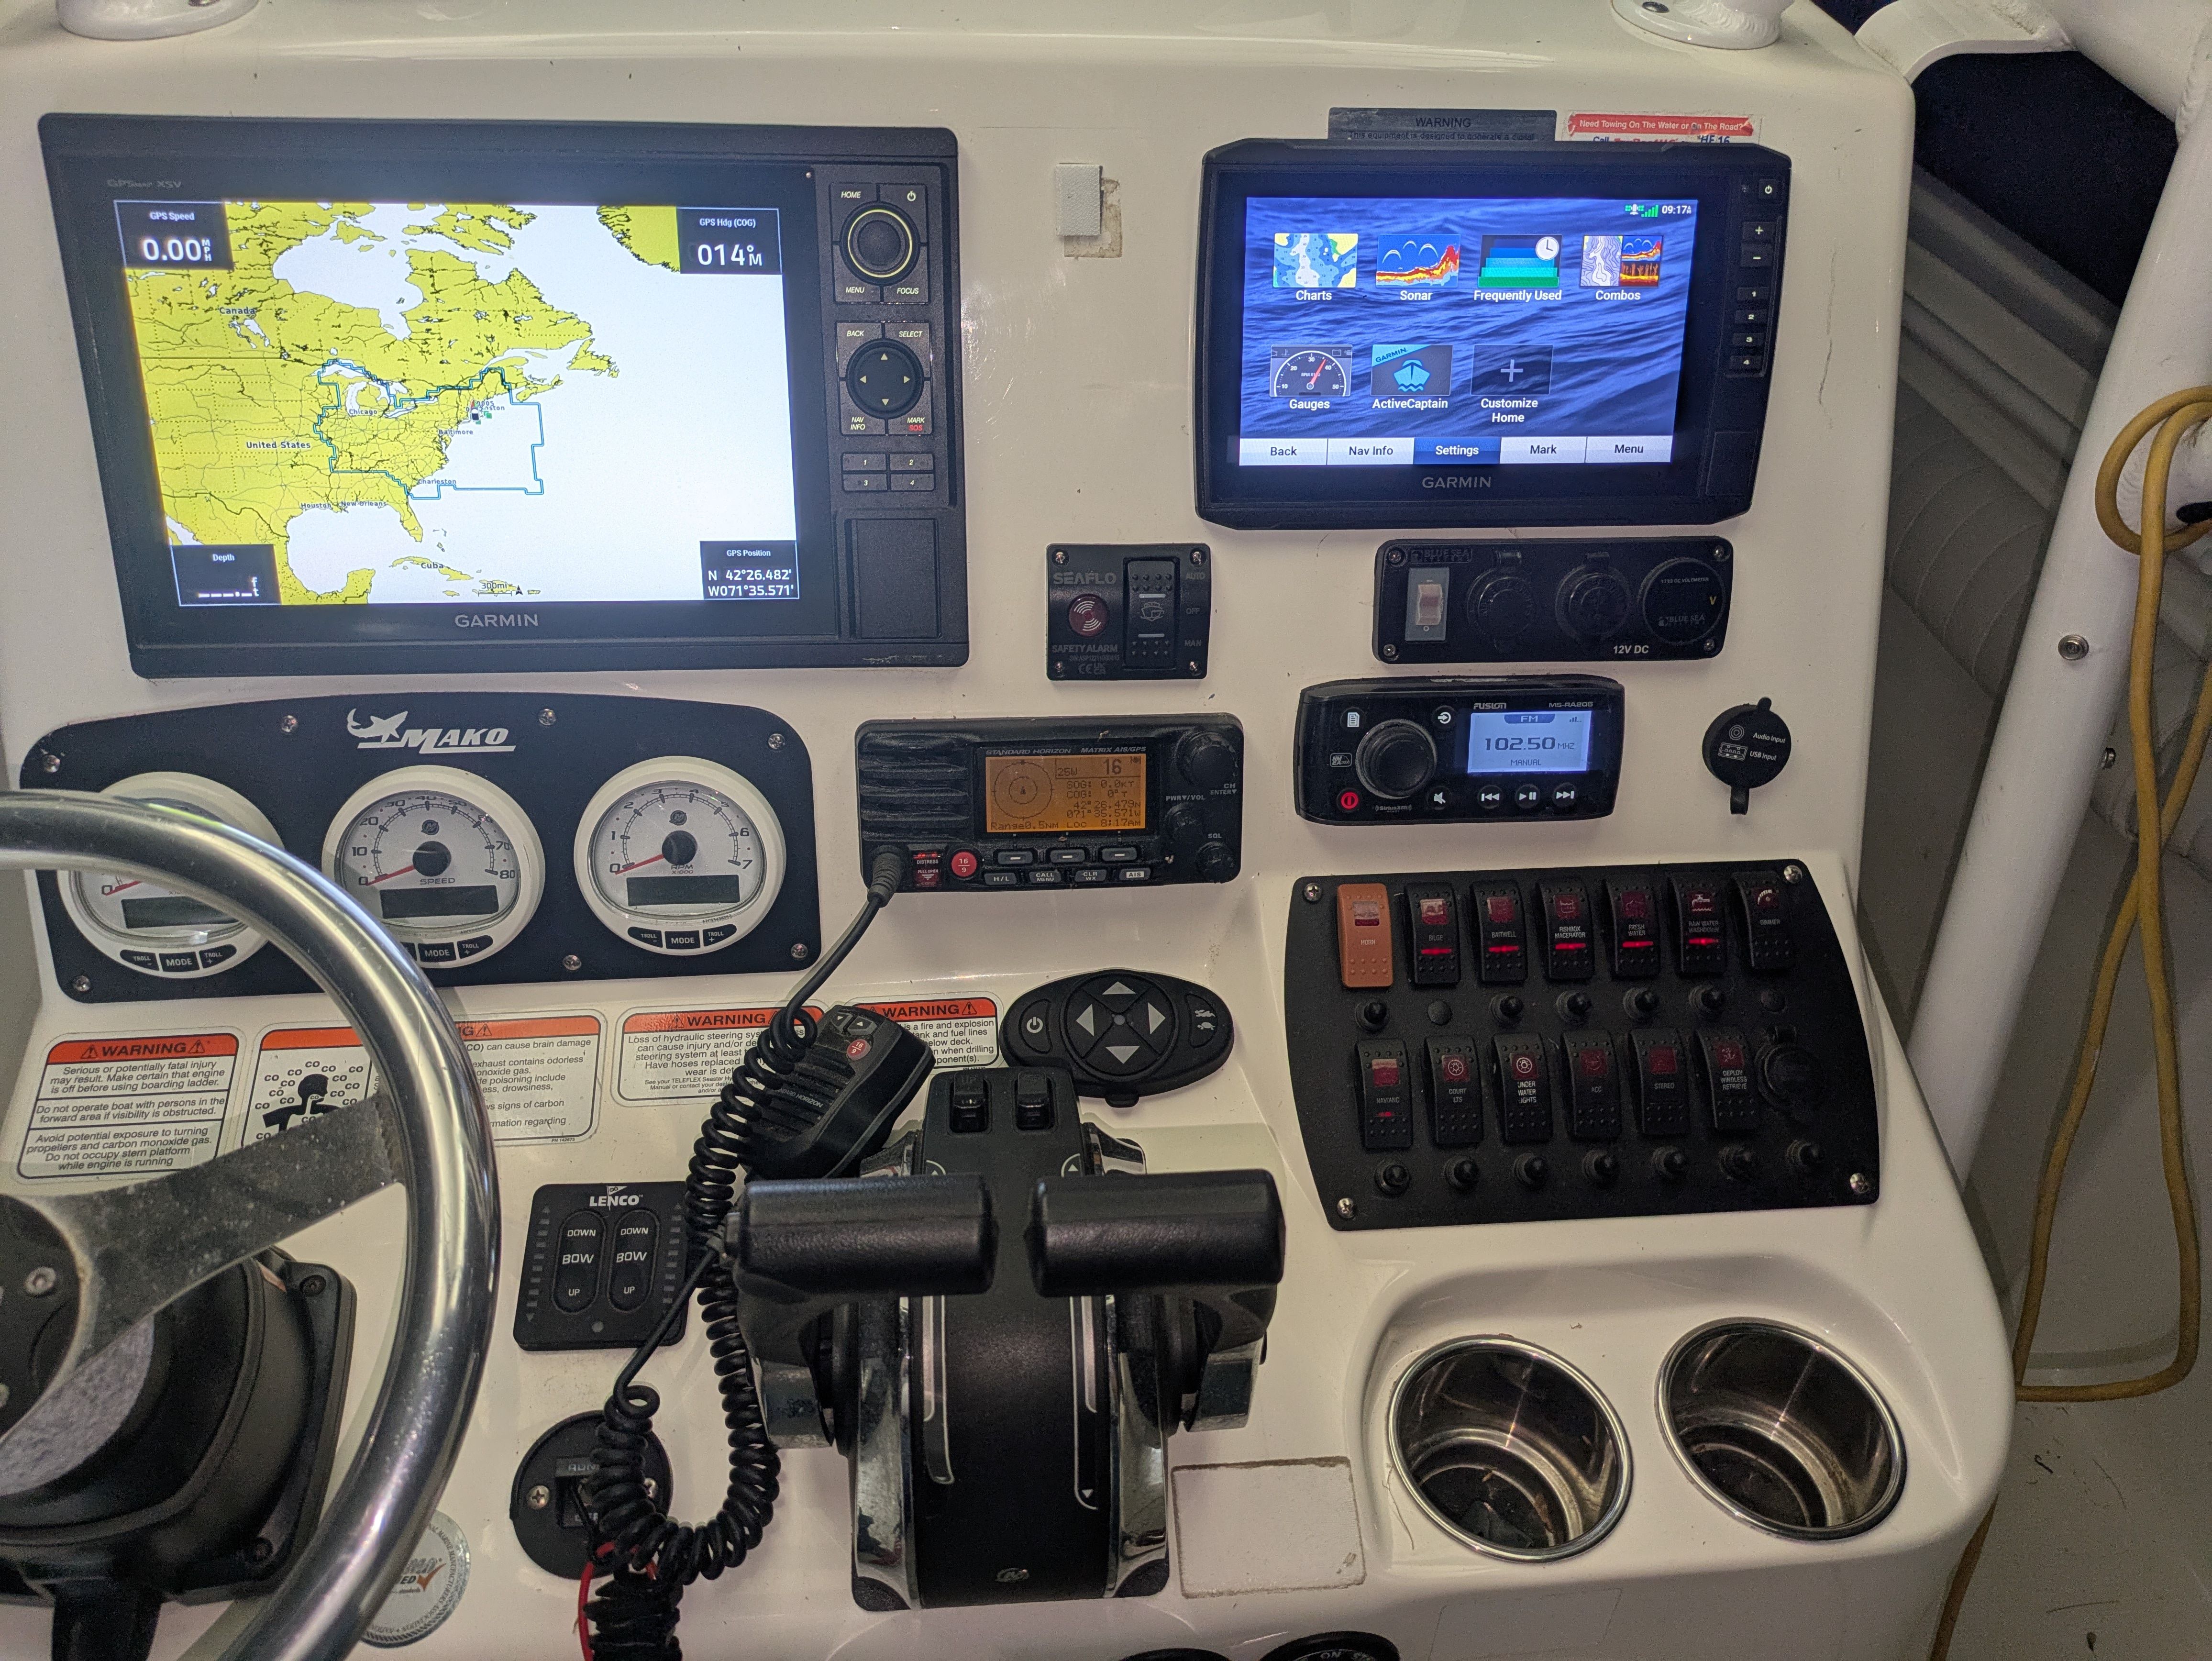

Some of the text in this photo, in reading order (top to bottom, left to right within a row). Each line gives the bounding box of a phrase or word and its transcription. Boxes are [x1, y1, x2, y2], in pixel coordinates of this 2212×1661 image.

[1416, 117, 1471, 127] WARNING
[1601, 121, 1626, 130] Towing
[150, 211, 195, 221] GPS Speed
[718, 219, 732, 228] Hdg
[734, 219, 756, 228] (COG)
[144, 239, 201, 261] 0.00
[1296, 290, 1332, 300] Charts
[1400, 290, 1433, 300] Sonar
[1474, 290, 1561, 302] Frequently Used
[1595, 290, 1640, 300] Combos
[219, 307, 256, 315] Canada
[1375, 347, 1408, 363] GARMIN
[1289, 399, 1330, 410] Gauges
[1372, 399, 1448, 410] ActiveCaptain
[1481, 398, 1538, 409] Customize
[1492, 413, 1524, 422] Home
[246, 441, 311, 449] United States
[1349, 446, 1393, 455] Nav Info
[1530, 445, 1557, 454] Mark
[1615, 444, 1644, 454] Menu
[1270, 446, 1297, 456] Back
[1436, 445, 1479, 457] Settings
[1422, 476, 1492, 488] GARMIN
[212, 554, 235, 562] Depth
[743, 549, 771, 557] Position
[708, 570, 717, 581] N
[1053, 573, 1117, 585] SEAFLO
[455, 614, 539, 627] GARMIN
[1613, 646, 1649, 654] 12V DC
[403, 728, 512, 753] MAKO
[1753, 732, 1786, 743] Audio Input
[1485, 737, 1556, 751] 102.50
[1058, 767, 1077, 776] 25W
[1103, 759, 1122, 775] 16
[166, 958, 192, 966] MODE
[882, 1004, 959, 1018] WARNING
[687, 1013, 766, 1027] WARNING
[954, 1019, 994, 1030] explosion
[629, 1031, 742, 1044] Loss of hydraulic steering
[102, 1042, 187, 1058] WARNING
[504, 1039, 591, 1050] cause brain damage
[63, 1066, 100, 1075] Serious
[116, 1062, 165, 1075] potentially
[167, 1061, 188, 1070] fatal
[190, 1060, 217, 1072] injury
[50, 1069, 225, 1086] may result. Make certain that engine
[51, 1078, 219, 1094] is off before using boarding ladder.
[589, 1195, 640, 1207] LENCO
[620, 1227, 648, 1235] DOWN
[562, 1253, 594, 1264] BOW
[616, 1251, 647, 1262] BOW
[568, 1288, 580, 1296] UP
